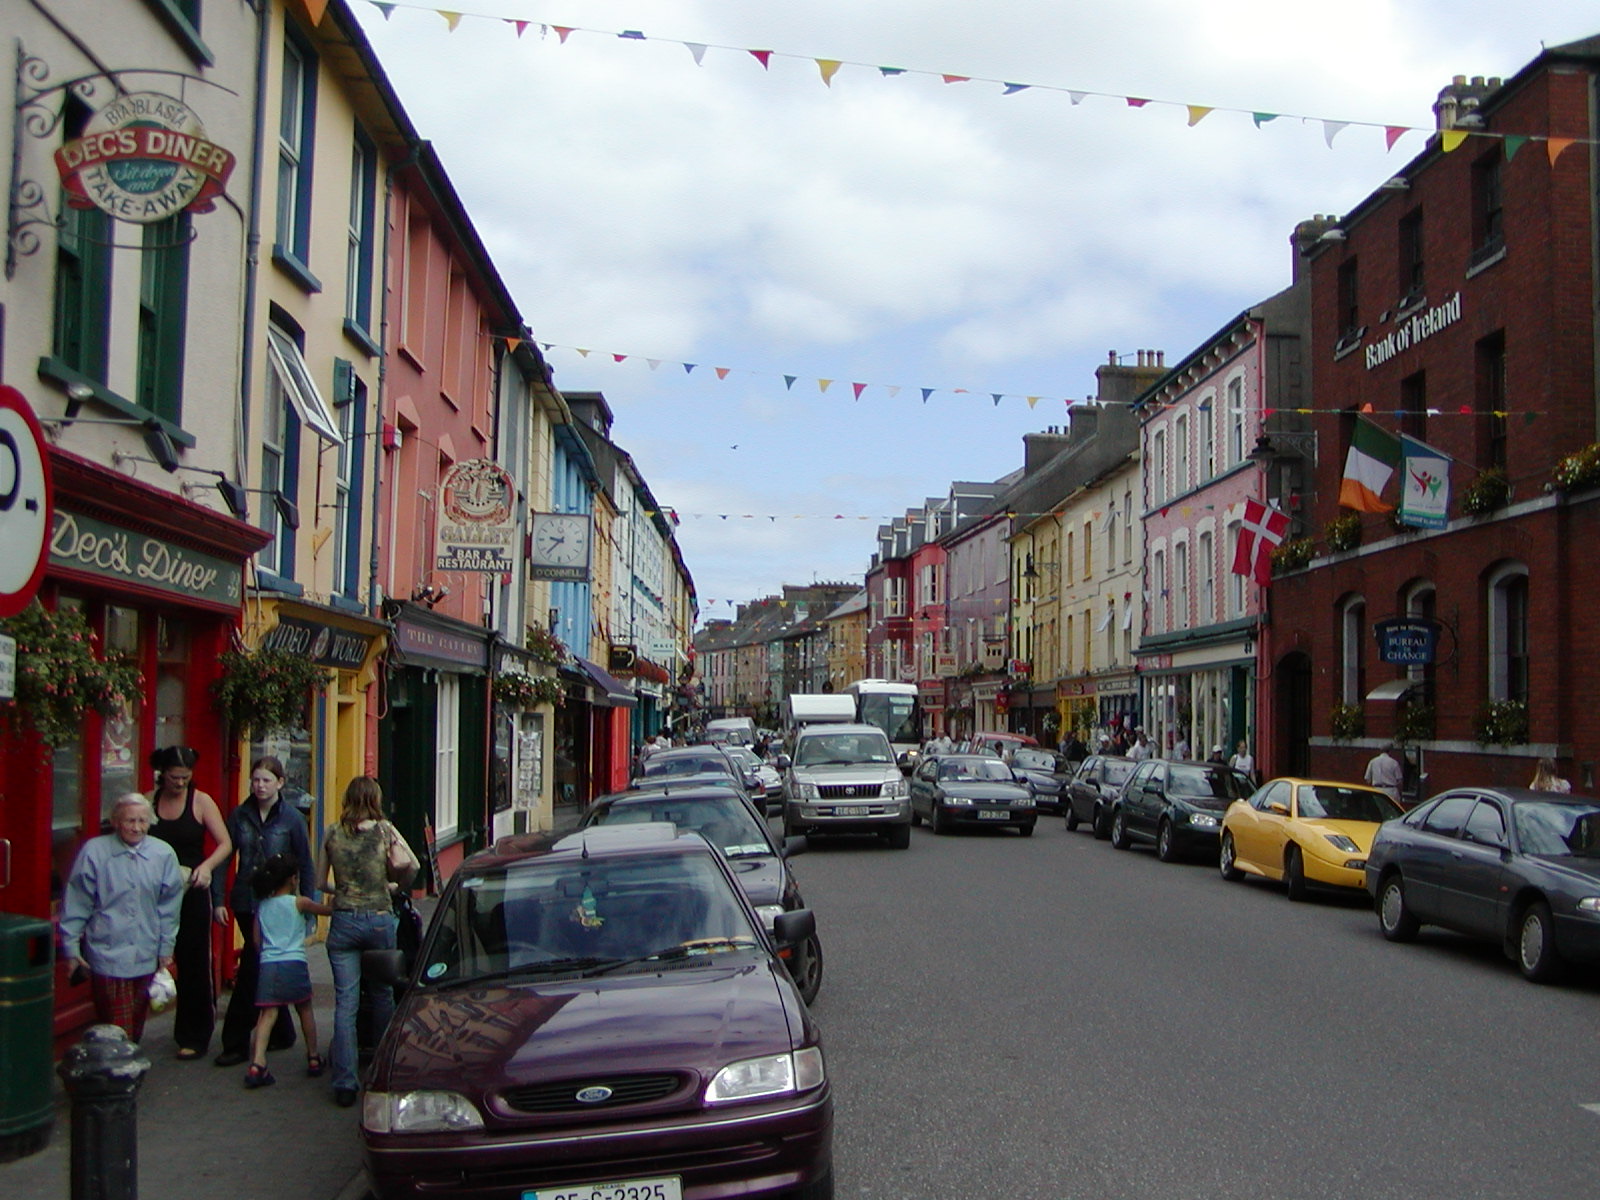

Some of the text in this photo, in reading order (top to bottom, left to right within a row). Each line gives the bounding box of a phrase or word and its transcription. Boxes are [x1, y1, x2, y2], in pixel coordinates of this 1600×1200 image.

[62, 131, 228, 173] DEC'S DINER
[88, 167, 198, 216] TAKE-AWAY
[1366, 291, 1461, 370] Bank of Ireland
[51, 509, 217, 592] Dec's Diner
[456, 549, 493, 560] BAR &
[437, 558, 512, 570] RESTAURANT
[264, 623, 368, 662] VIDEO WORLD
[407, 628, 434, 646] THE
[1389, 637, 1427, 647] BUREAU
[1387, 652, 1427, 660] CHANGE
[554, 1184, 666, 1200] --2325
